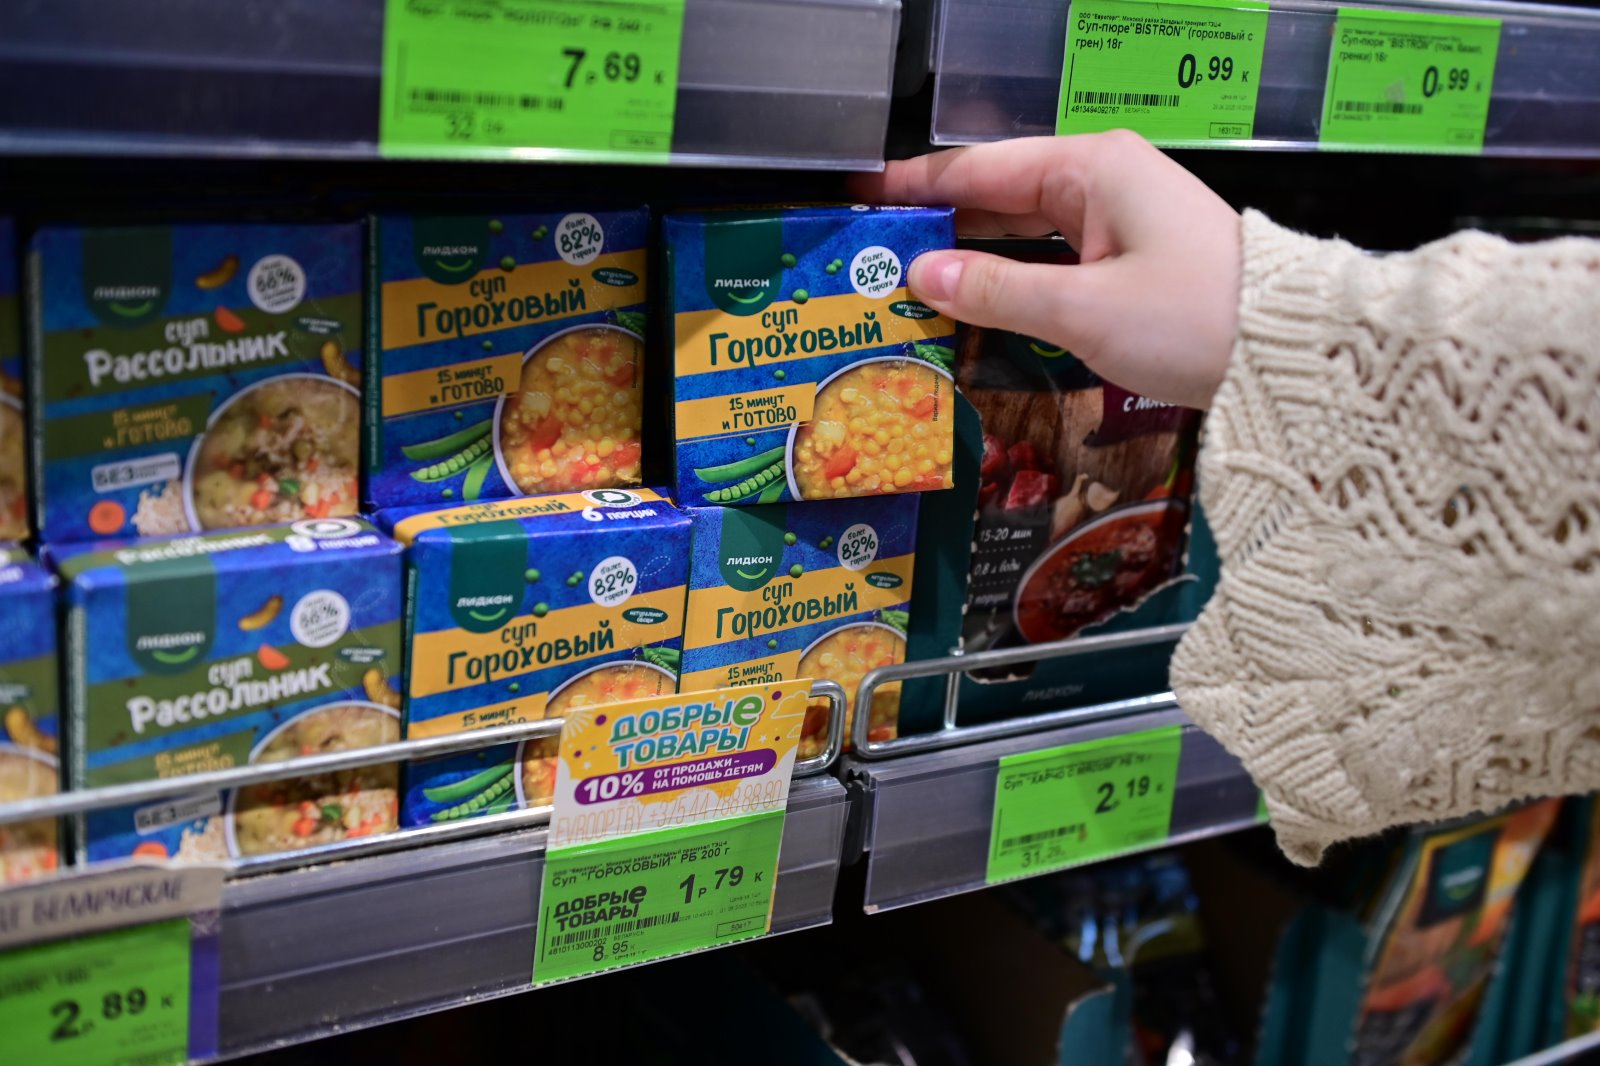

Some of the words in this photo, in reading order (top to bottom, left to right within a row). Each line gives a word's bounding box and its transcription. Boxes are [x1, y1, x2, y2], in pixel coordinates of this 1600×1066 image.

[1075, 37, 1104, 51] грен)
[1107, 39, 1123, 50] 18г
[1188, 29, 1245, 41] (гороховый
[562, 46, 586, 89] 7
[604, 51, 642, 83] 69
[1178, 53, 1196, 89] 0
[1208, 56, 1233, 81] 99
[1423, 65, 1439, 98] 0
[1448, 68, 1470, 91] 99
[561, 223, 601, 253] 82%
[856, 258, 899, 286] 82%
[470, 276, 506, 301] суп
[868, 280, 894, 293] гороха
[417, 278, 587, 339] Гороховый
[761, 308, 799, 333] суп
[165, 318, 210, 347] суп
[709, 312, 883, 369] Гороховый
[84, 331, 289, 387] Рассольник
[438, 369, 453, 384] 15
[441, 378, 504, 403] ГОТОВО
[729, 398, 743, 411] 15
[746, 394, 785, 410] минут
[722, 420, 730, 430] и
[733, 405, 797, 430] ГОТОВО
[581, 505, 604, 522] 6
[841, 533, 876, 561] 82%
[847, 528, 866, 541] более
[980, 527, 1009, 543] 15-20
[594, 567, 634, 596] 82%
[762, 582, 793, 605] суп
[716, 583, 858, 640] Гороховый
[501, 622, 538, 647] суп
[447, 620, 615, 686] Гороховый
[208, 657, 253, 689] суп
[727, 667, 740, 680] 15
[742, 662, 776, 678] минут
[127, 662, 332, 734] Рассольник
[462, 713, 477, 727] 15
[613, 725, 751, 769] ТОВАРЫ
[652, 778, 670, 790] НА
[671, 770, 723, 788] ПОМОЩЬ
[723, 762, 764, 779] ДЕТЯМ
[653, 767, 671, 779] ОТ
[671, 757, 733, 776] ПРОДАЖИ
[583, 771, 645, 802] 10%
[1004, 779, 1023, 791] Суп
[1095, 781, 1115, 815] 2
[1126, 775, 1150, 799] 19
[552, 876, 577, 887] Суп
[581, 854, 677, 881] "ГОРОХОВЫЙ"
[680, 852, 697, 864] РБ
[701, 847, 721, 859] 200
[724, 847, 731, 856] г
[679, 873, 696, 904] 1
[714, 865, 744, 890] 79
[556, 903, 640, 932] ТОВАРЫ
[548, 937, 608, 955] 4810113000202
[593, 945, 605, 962] 8
[612, 940, 629, 955] 95
[49, 998, 81, 1044] 2
[101, 986, 147, 1021] 89
